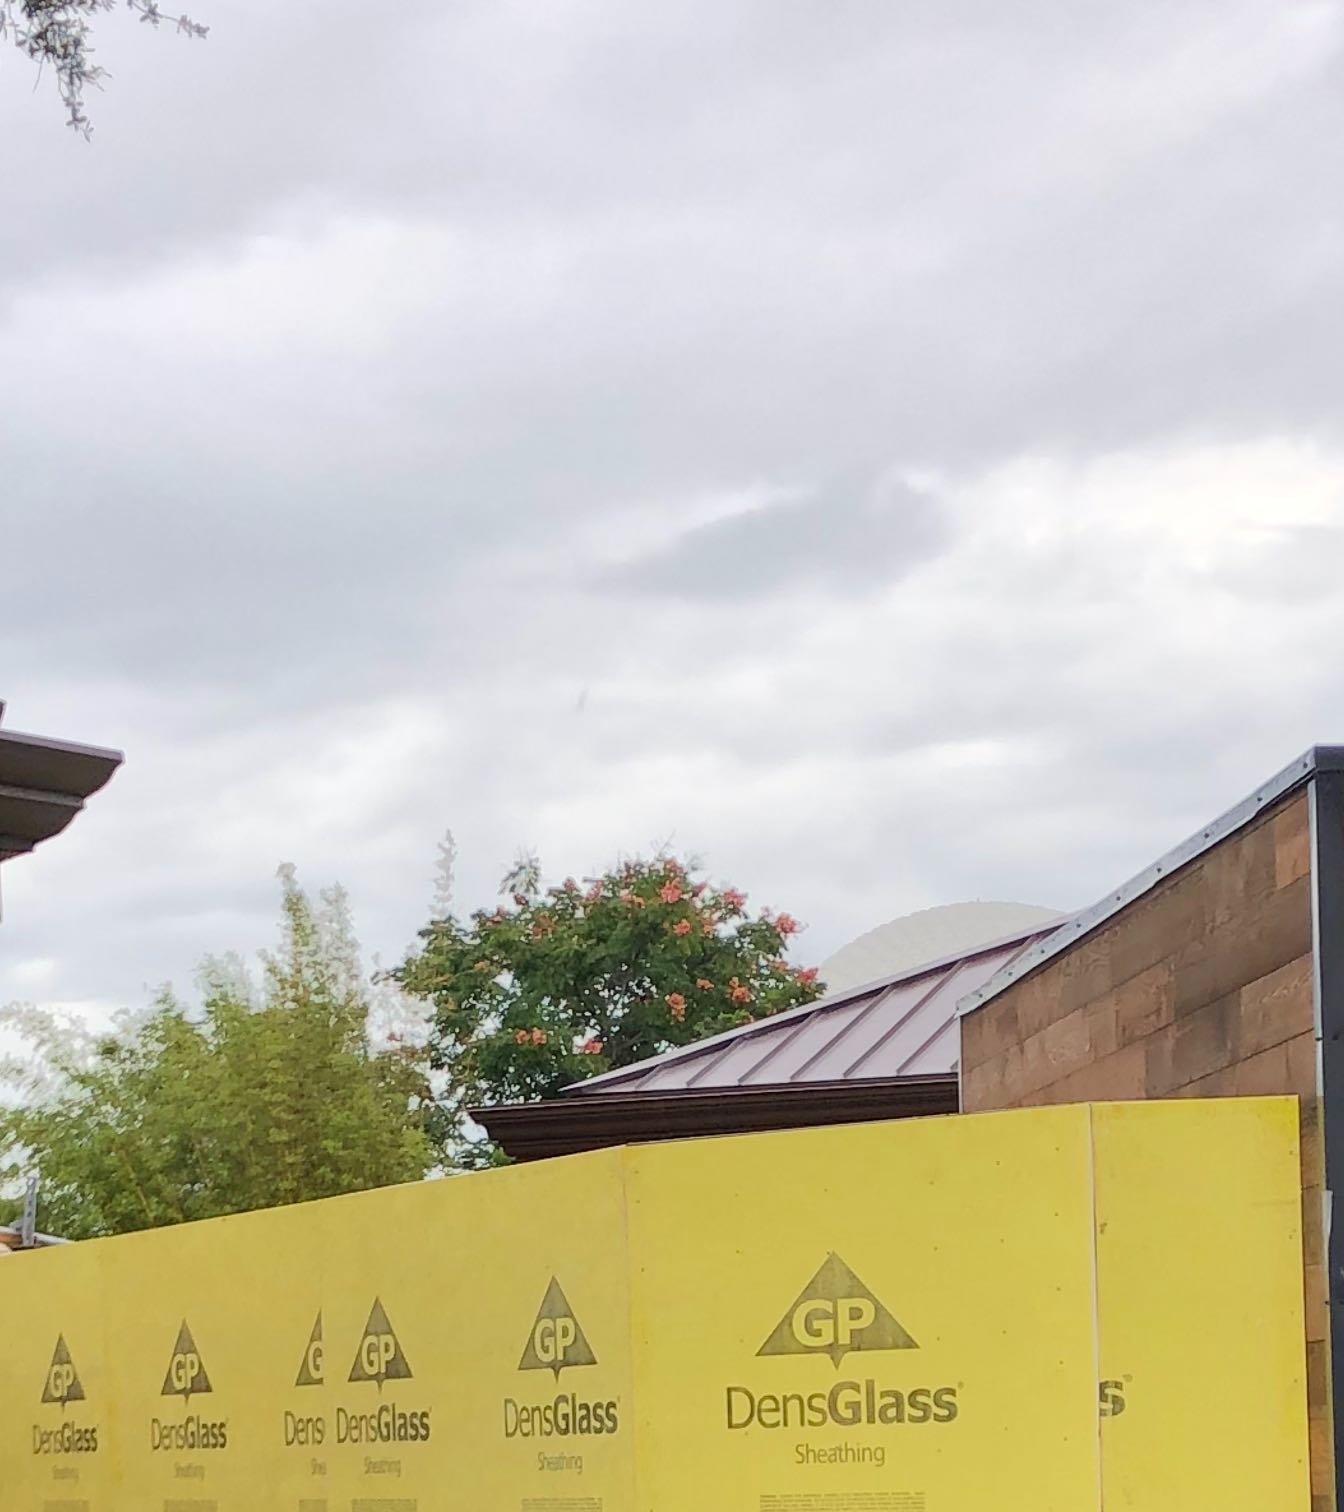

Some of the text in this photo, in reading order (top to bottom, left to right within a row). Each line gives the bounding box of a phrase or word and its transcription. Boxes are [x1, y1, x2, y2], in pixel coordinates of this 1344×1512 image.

[534, 1317, 576, 1363] GP
[792, 1297, 876, 1348] GP
[170, 1352, 200, 1390] GP
[362, 1334, 396, 1376] GP
[49, 1363, 75, 1398] GP
[336, 1403, 431, 1444] DensGlass
[504, 1393, 618, 1439] DensGlass
[726, 1378, 959, 1430] DensGlass
[32, 1421, 98, 1455] DensGlass
[151, 1416, 228, 1451] DensGlass
[795, 1442, 886, 1467] Sheathing
